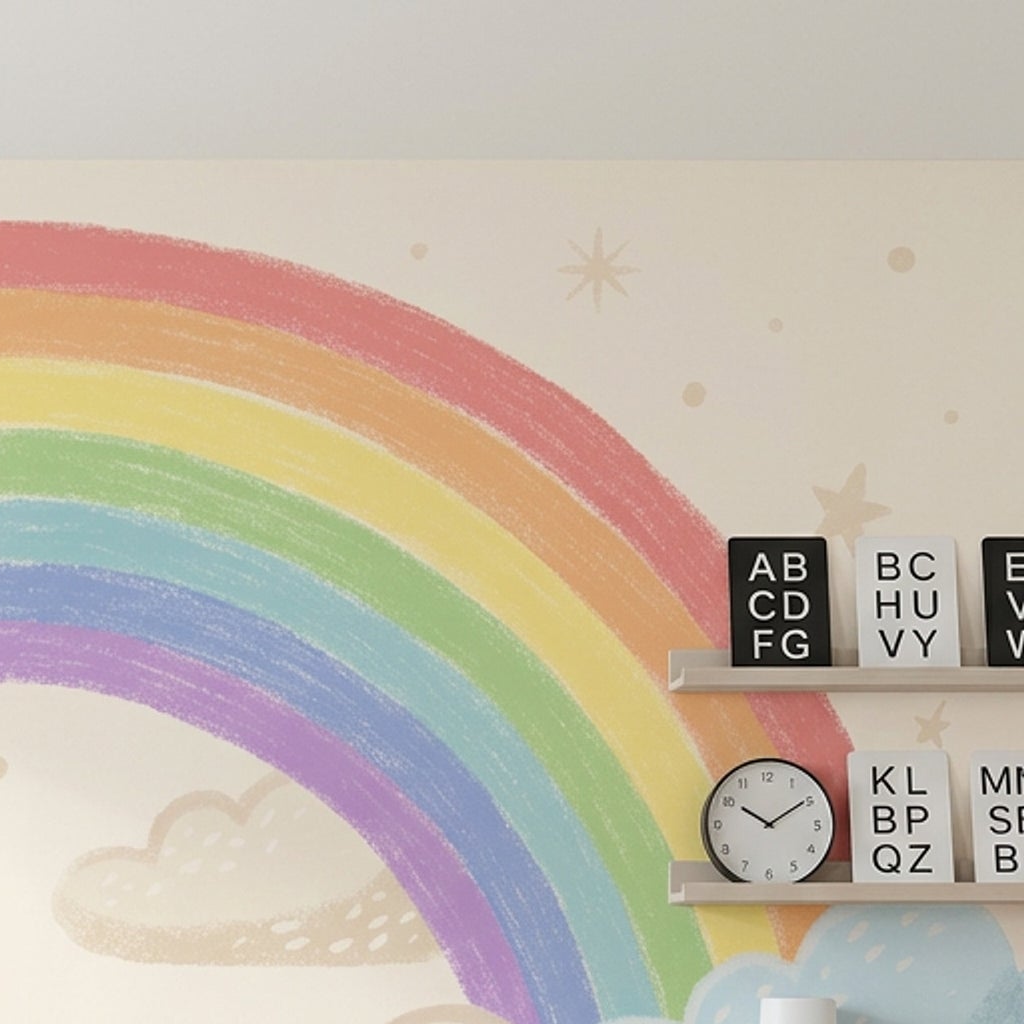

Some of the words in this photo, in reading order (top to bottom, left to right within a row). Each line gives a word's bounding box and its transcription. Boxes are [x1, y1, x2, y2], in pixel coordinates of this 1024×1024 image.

[748, 552, 808, 582] AB
[748, 590, 810, 621] CD
[753, 629, 810, 660] FG
[761, 772, 774, 783] 12
[740, 860, 750, 872] 7
[994, 844, 1019, 873] B
[764, 868, 774, 881] 6
